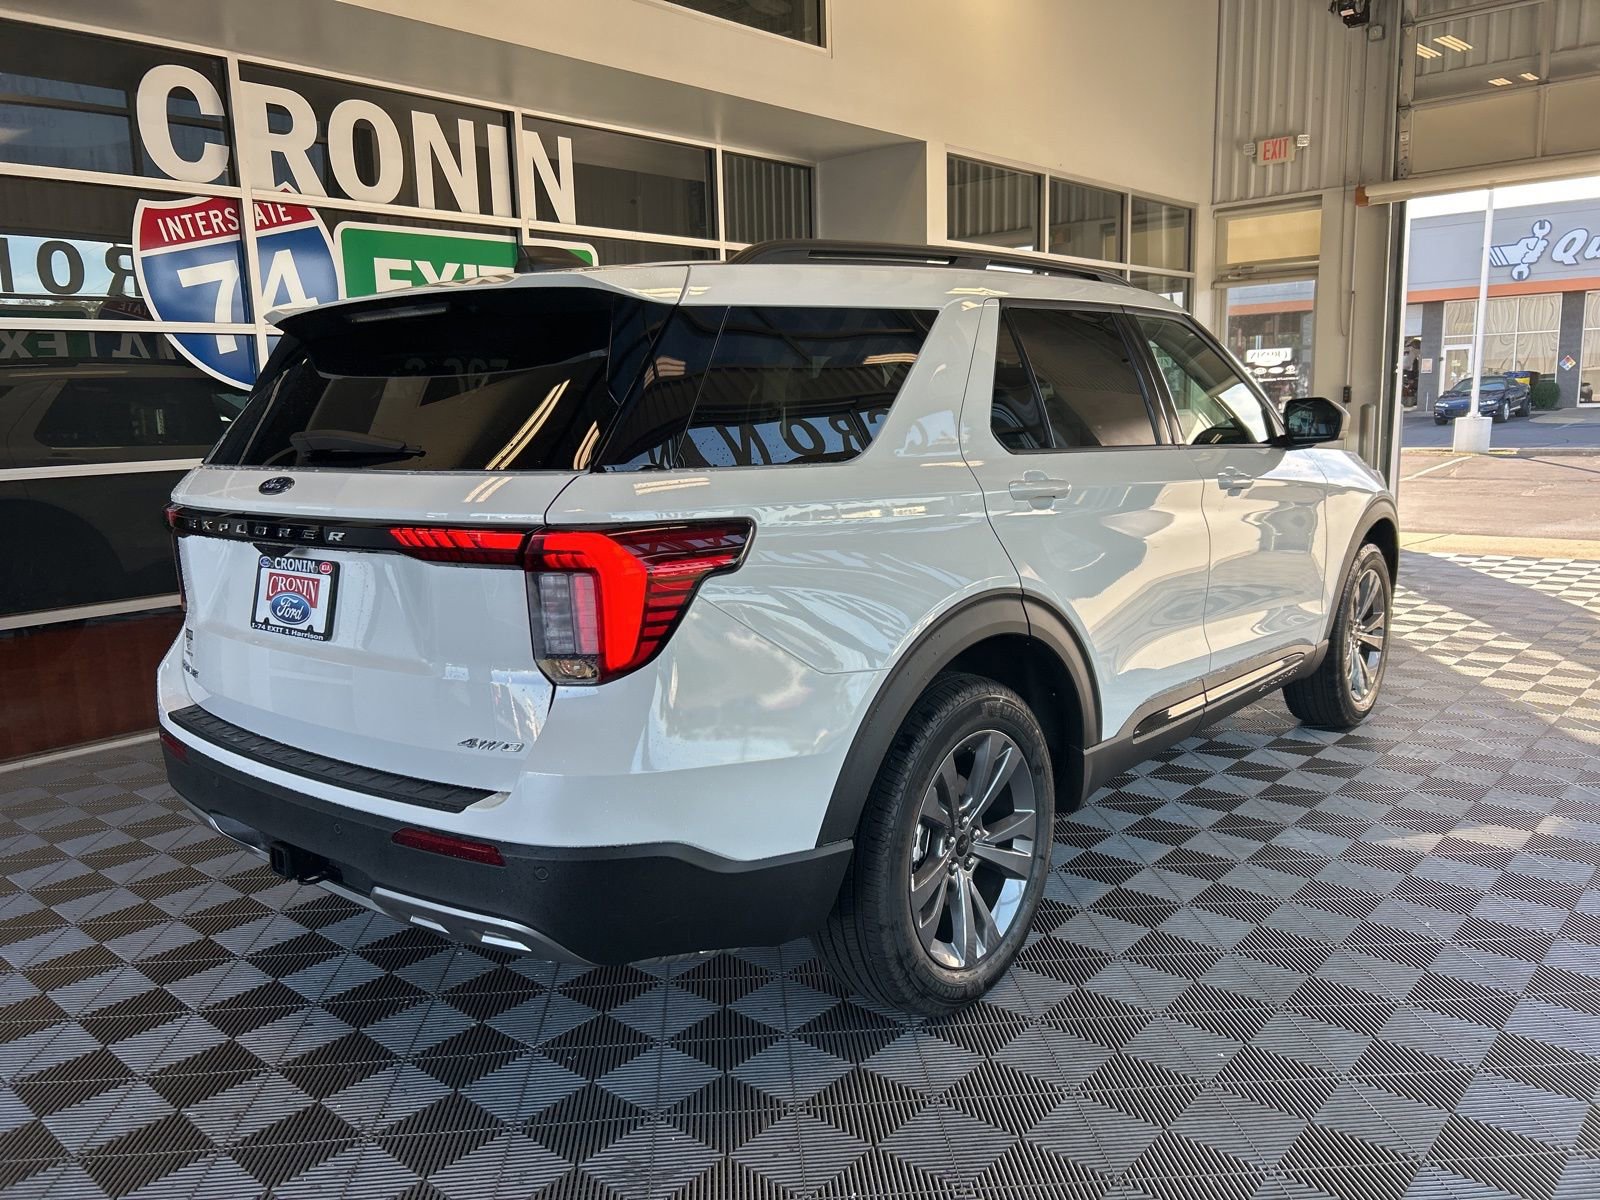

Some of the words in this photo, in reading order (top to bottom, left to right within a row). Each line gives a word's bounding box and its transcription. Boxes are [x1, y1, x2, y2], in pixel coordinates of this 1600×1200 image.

[136, 64, 577, 225] CRONIN
[1263, 136, 1289, 161] EXIT
[157, 202, 293, 243] INTERSATE
[374, 257, 515, 293] EX
[177, 249, 319, 355] 74
[187, 519, 346, 542] EXPLORER
[274, 557, 316, 573] CRONIN
[269, 575, 318, 603] CRONIN
[276, 596, 305, 620] Ford
[267, 625, 284, 633] EXIT
[291, 628, 324, 641] Harrison
